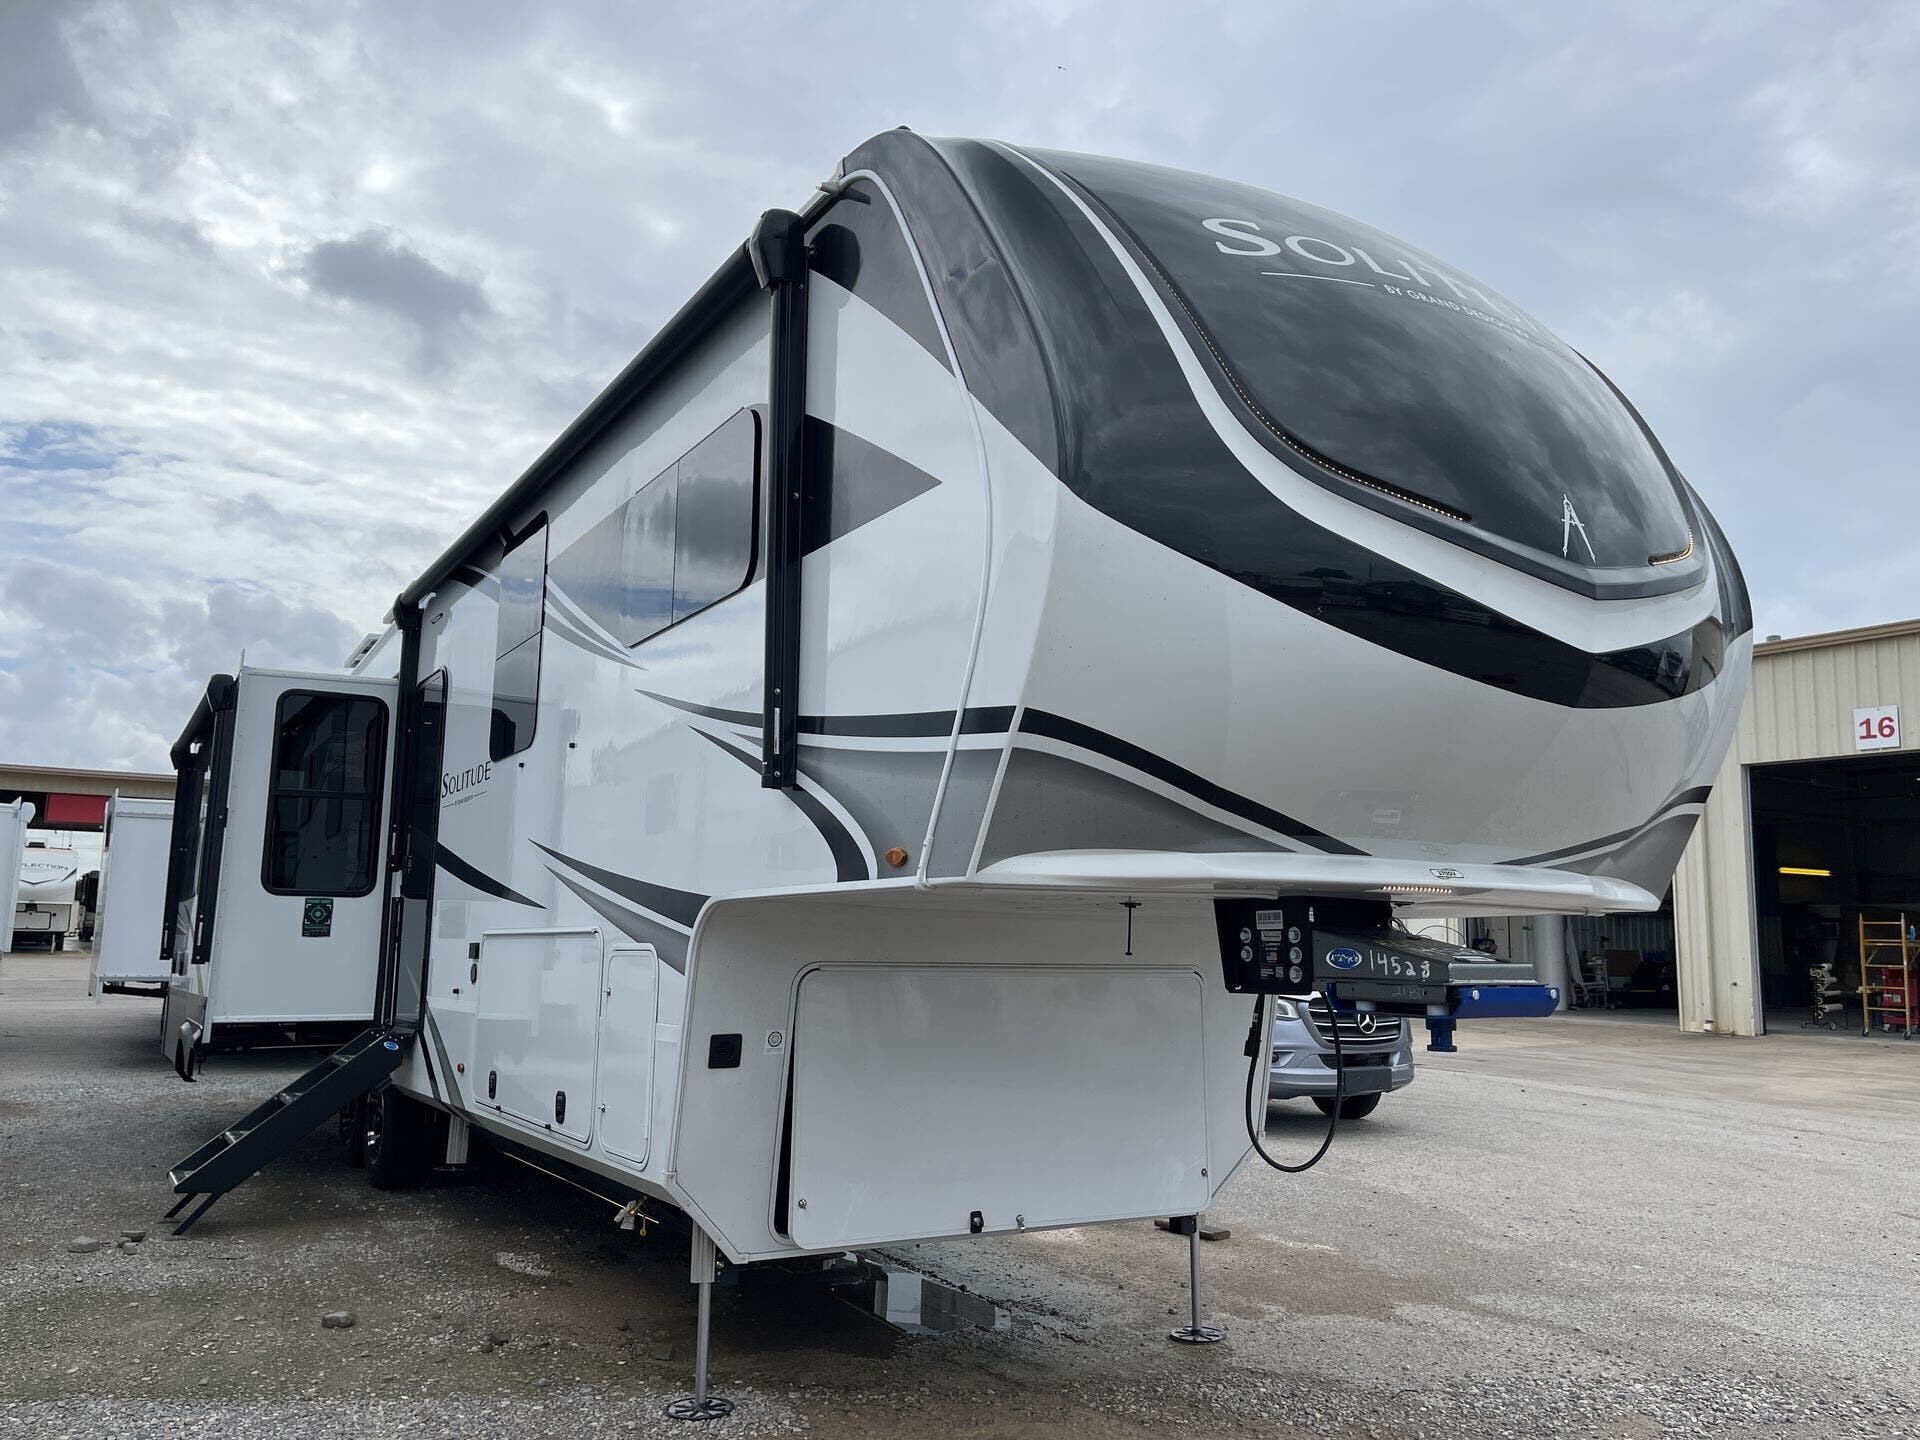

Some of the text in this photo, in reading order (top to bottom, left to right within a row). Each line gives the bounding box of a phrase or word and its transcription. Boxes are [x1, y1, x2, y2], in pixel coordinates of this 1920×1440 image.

[1383, 283, 1402, 296] BY
[1406, 289, 1460, 311] GRAND
[1858, 716, 1895, 740] 16
[441, 760, 492, 798] SOLITUDE
